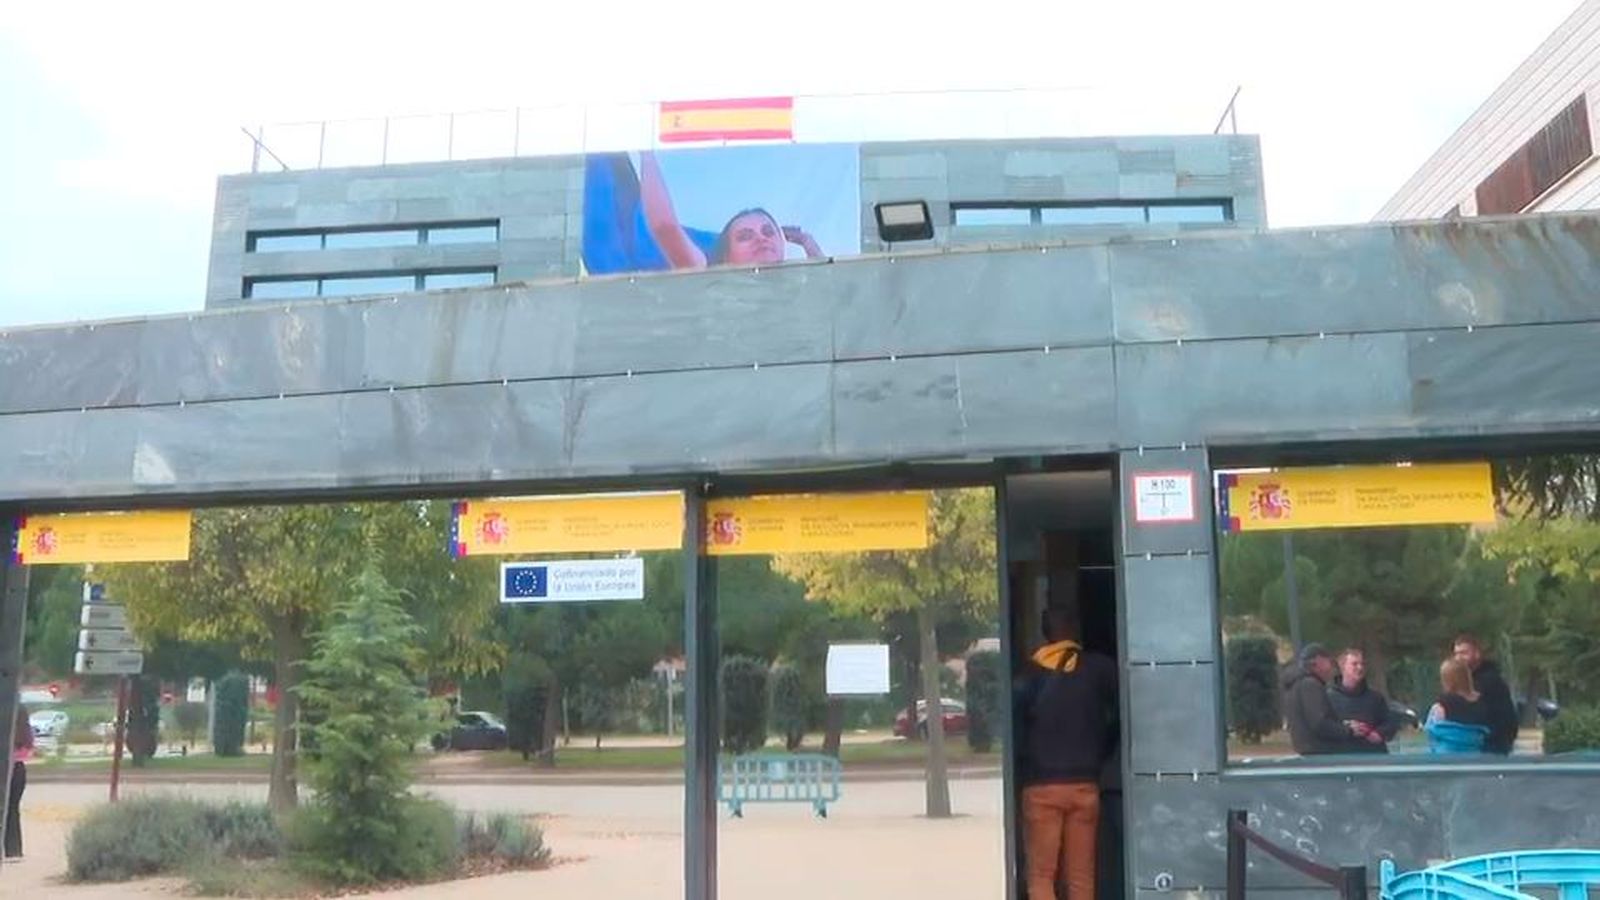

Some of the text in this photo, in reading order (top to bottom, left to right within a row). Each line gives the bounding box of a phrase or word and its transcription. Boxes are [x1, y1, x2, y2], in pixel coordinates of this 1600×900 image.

[1160, 479, 1176, 491] 100
[553, 567, 637, 581] Cofinanciado por
[564, 580, 592, 592] Unión
[595, 581, 636, 593] Europea
